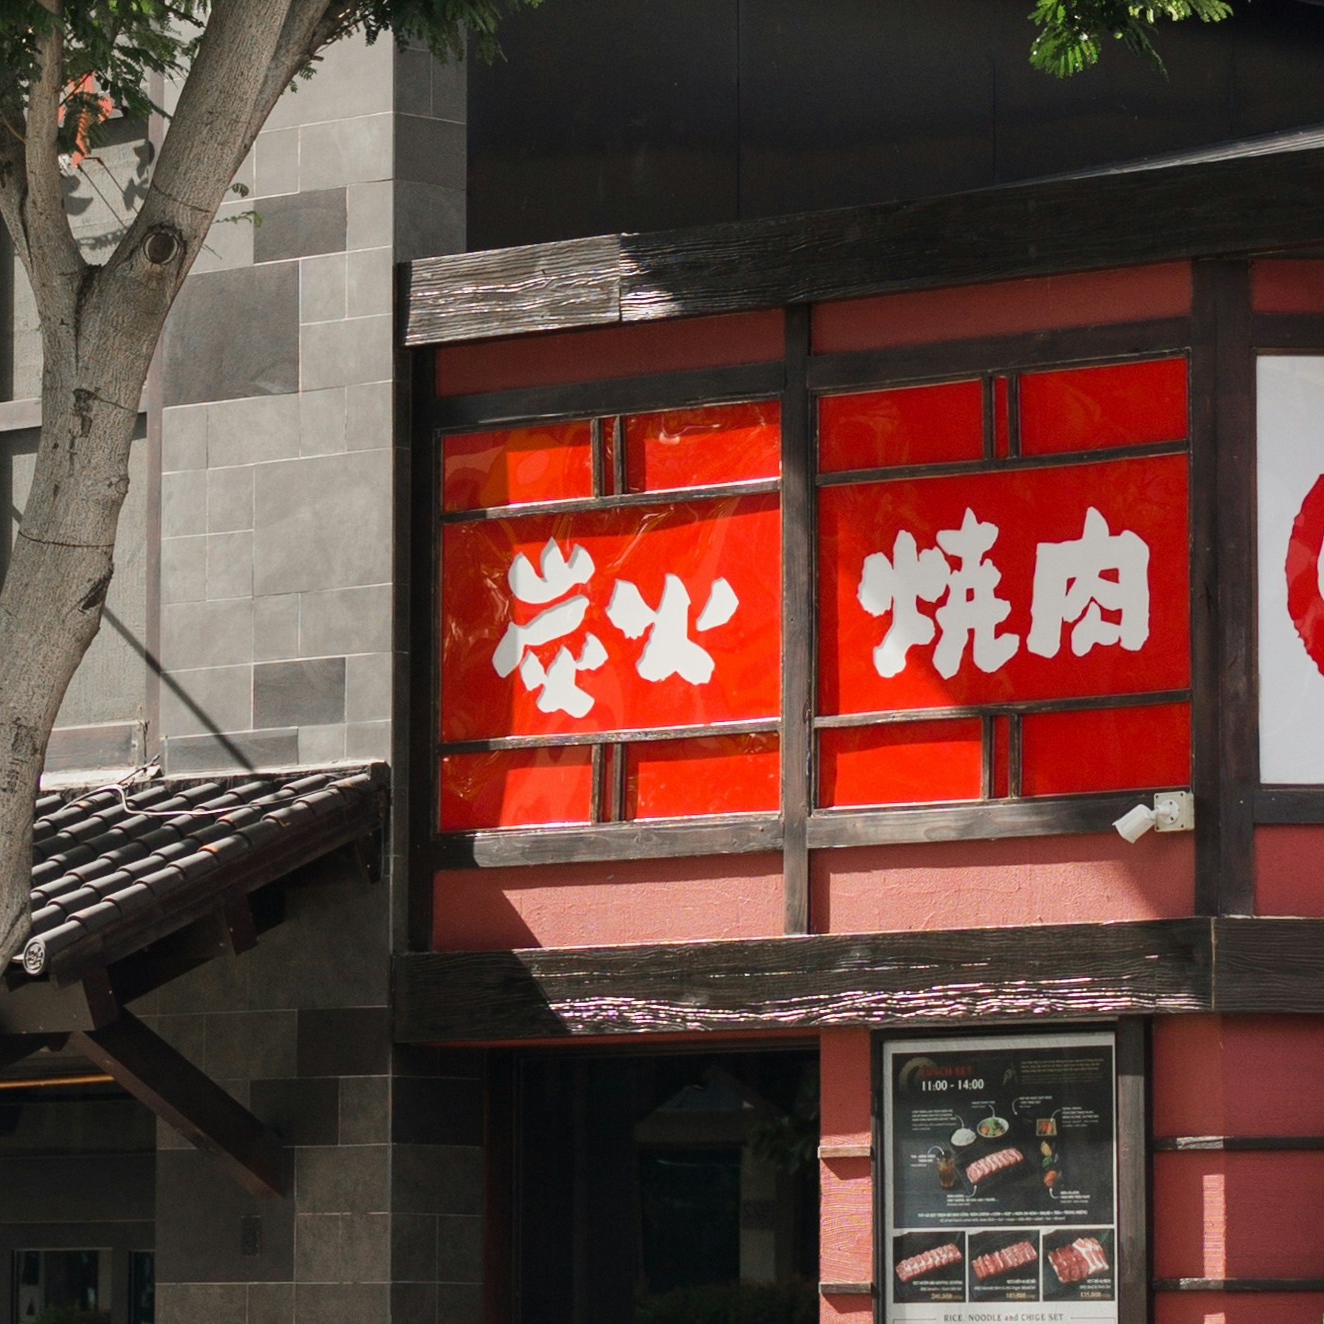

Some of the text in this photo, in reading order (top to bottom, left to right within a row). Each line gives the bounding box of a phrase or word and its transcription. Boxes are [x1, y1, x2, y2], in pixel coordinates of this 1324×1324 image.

[493, 507, 1151, 718] 炭火 焼肉
[922, 1080, 948, 1092] 11:00
[958, 1078, 984, 1090] 14:00
[969, 1313, 1002, 1322] NOODLE
[1005, 1313, 1019, 1322] and
[1048, 1312, 1064, 1321] SET
